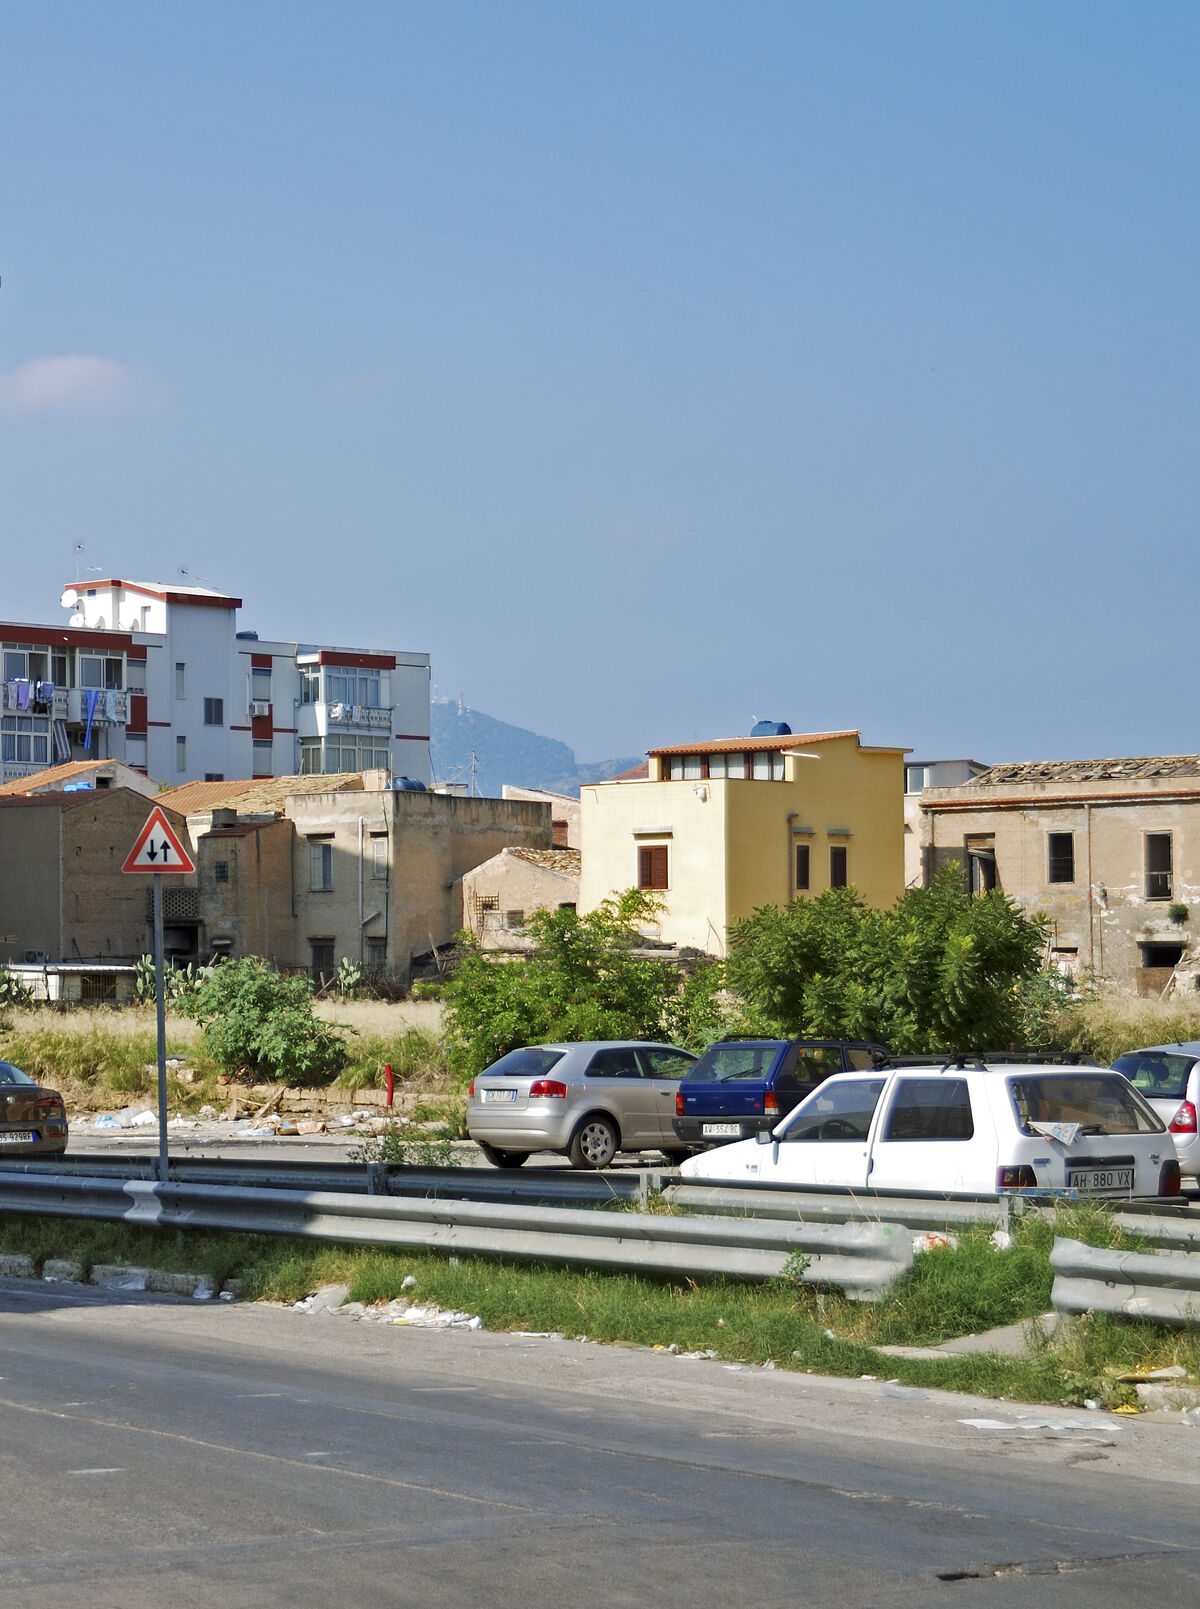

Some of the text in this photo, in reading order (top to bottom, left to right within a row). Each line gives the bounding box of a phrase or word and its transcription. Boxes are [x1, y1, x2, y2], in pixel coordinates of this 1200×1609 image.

[1073, 1171, 1130, 1188] AH 880 VX
